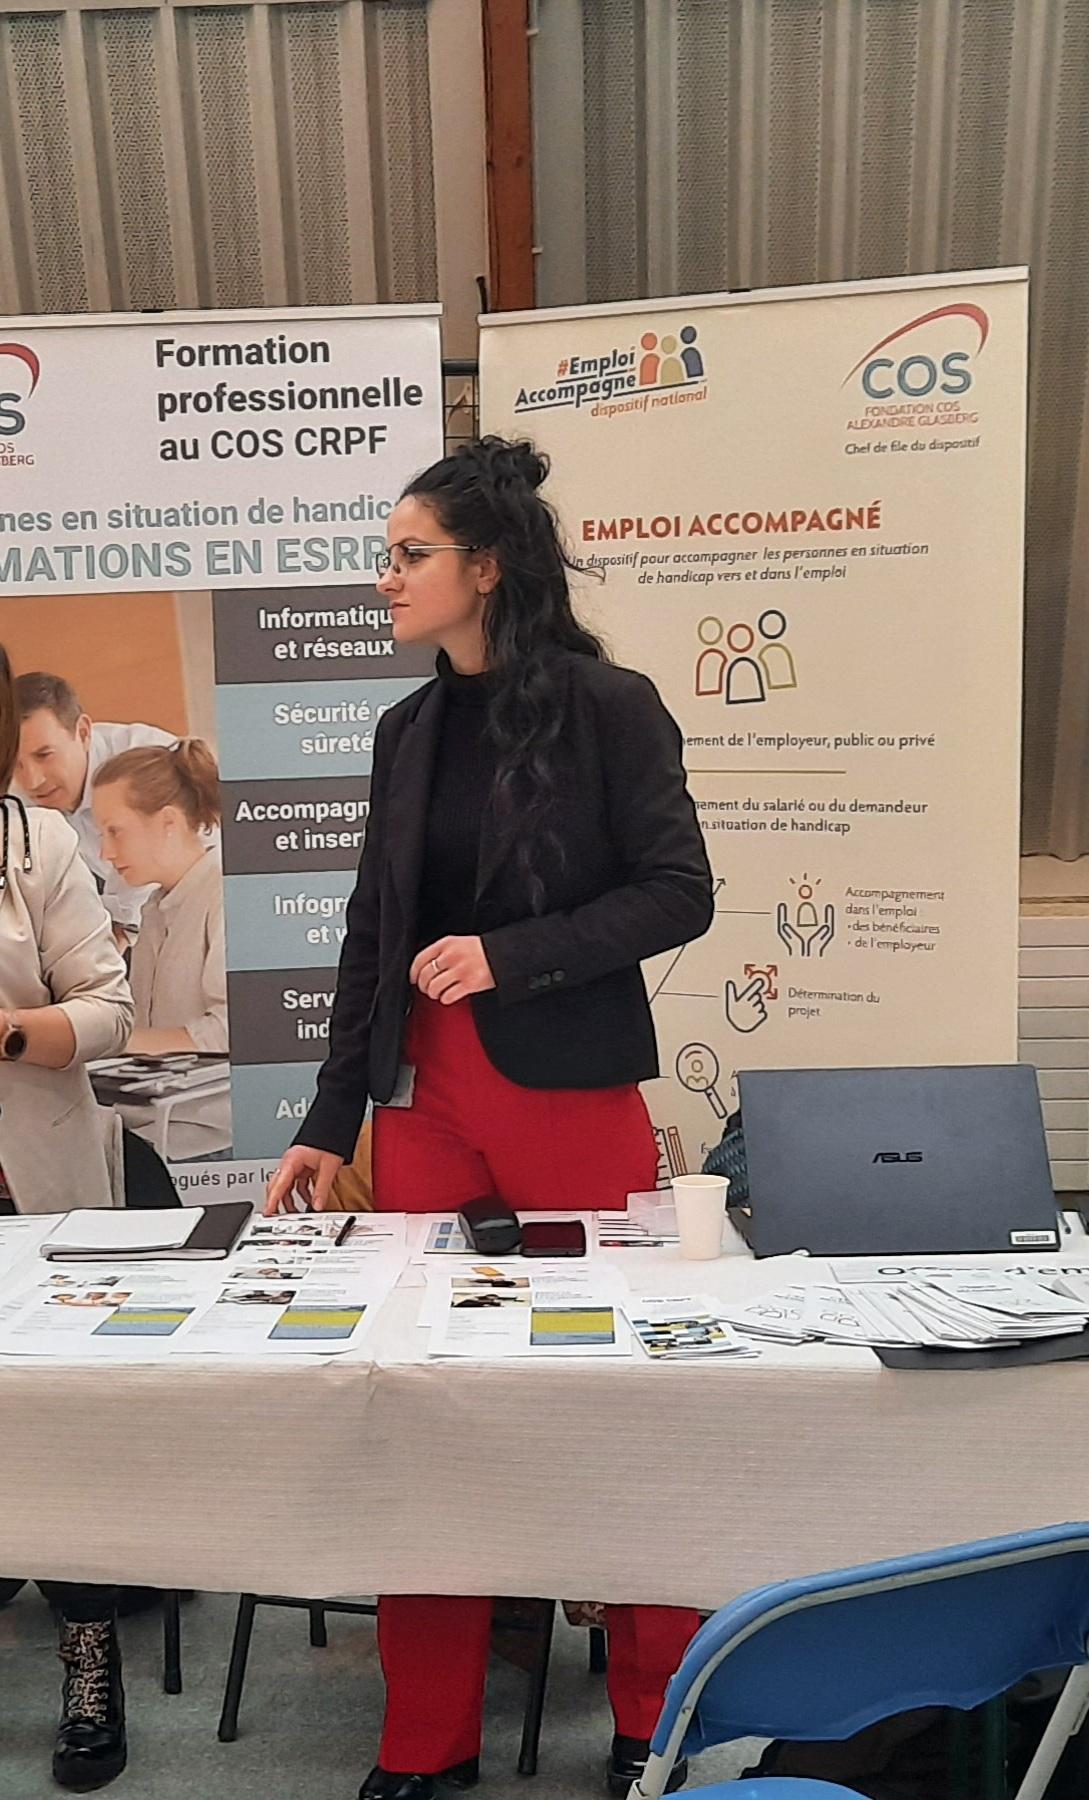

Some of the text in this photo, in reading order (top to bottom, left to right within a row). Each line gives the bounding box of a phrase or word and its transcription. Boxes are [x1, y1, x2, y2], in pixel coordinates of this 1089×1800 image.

[156, 335, 330, 368] Formation
[557, 346, 636, 377] #Emploi
[862, 352, 972, 399] COS
[158, 377, 424, 422] professionnelle
[591, 386, 708, 418] dispositif national
[865, 403, 933, 417] FONDATION
[847, 415, 916, 430] ALEXANDRE
[160, 425, 388, 461] au COS CRPF
[845, 443, 871, 455] Chef
[873, 441, 888, 453] de
[62, 510, 98, 530] en
[107, 501, 238, 529] situation
[247, 497, 284, 524] de
[293, 494, 393, 523] handic
[582, 500, 882, 541] EMPLOI ACCOMPAGNÉ
[206, 540, 262, 575] EN
[586, 551, 639, 569] dispositif
[640, 553, 670, 568] pour
[672, 550, 758, 567] accompagner
[763, 547, 780, 560] les
[782, 547, 848, 563] personnes
[851, 546, 867, 557] en
[870, 541, 930, 556] situation
[638, 565, 847, 586] de handicap vers et dans l'emploi
[258, 606, 394, 630] Informatiqu
[274, 637, 394, 660] et réseaux
[273, 702, 370, 725] Sécurité
[301, 731, 374, 754] sûreté
[728, 733, 744, 746] de
[747, 732, 831, 751] l'employeur,
[834, 733, 874, 750] public
[877, 737, 895, 747] ou
[899, 734, 936, 750] privé
[235, 801, 370, 824] Accompagn
[742, 797, 760, 811] du
[762, 797, 805, 812] salarié
[808, 802, 826, 812] ou
[828, 799, 846, 812] du
[850, 801, 929, 814] demandeur
[711, 818, 767, 831] situation
[770, 819, 788, 832] de
[791, 819, 851, 836] handicap
[275, 829, 362, 850] et inser
[274, 891, 349, 918] Infogr
[845, 903, 870, 916] dans
[306, 924, 331, 945] et
[852, 922, 870, 932] des
[855, 937, 868, 948] de
[282, 989, 335, 1010] Serv
[788, 987, 880, 1003] Détermination du
[788, 1006, 820, 1019] projet
[872, 1151, 923, 1164] ASUS
[227, 1172, 255, 1188] par
